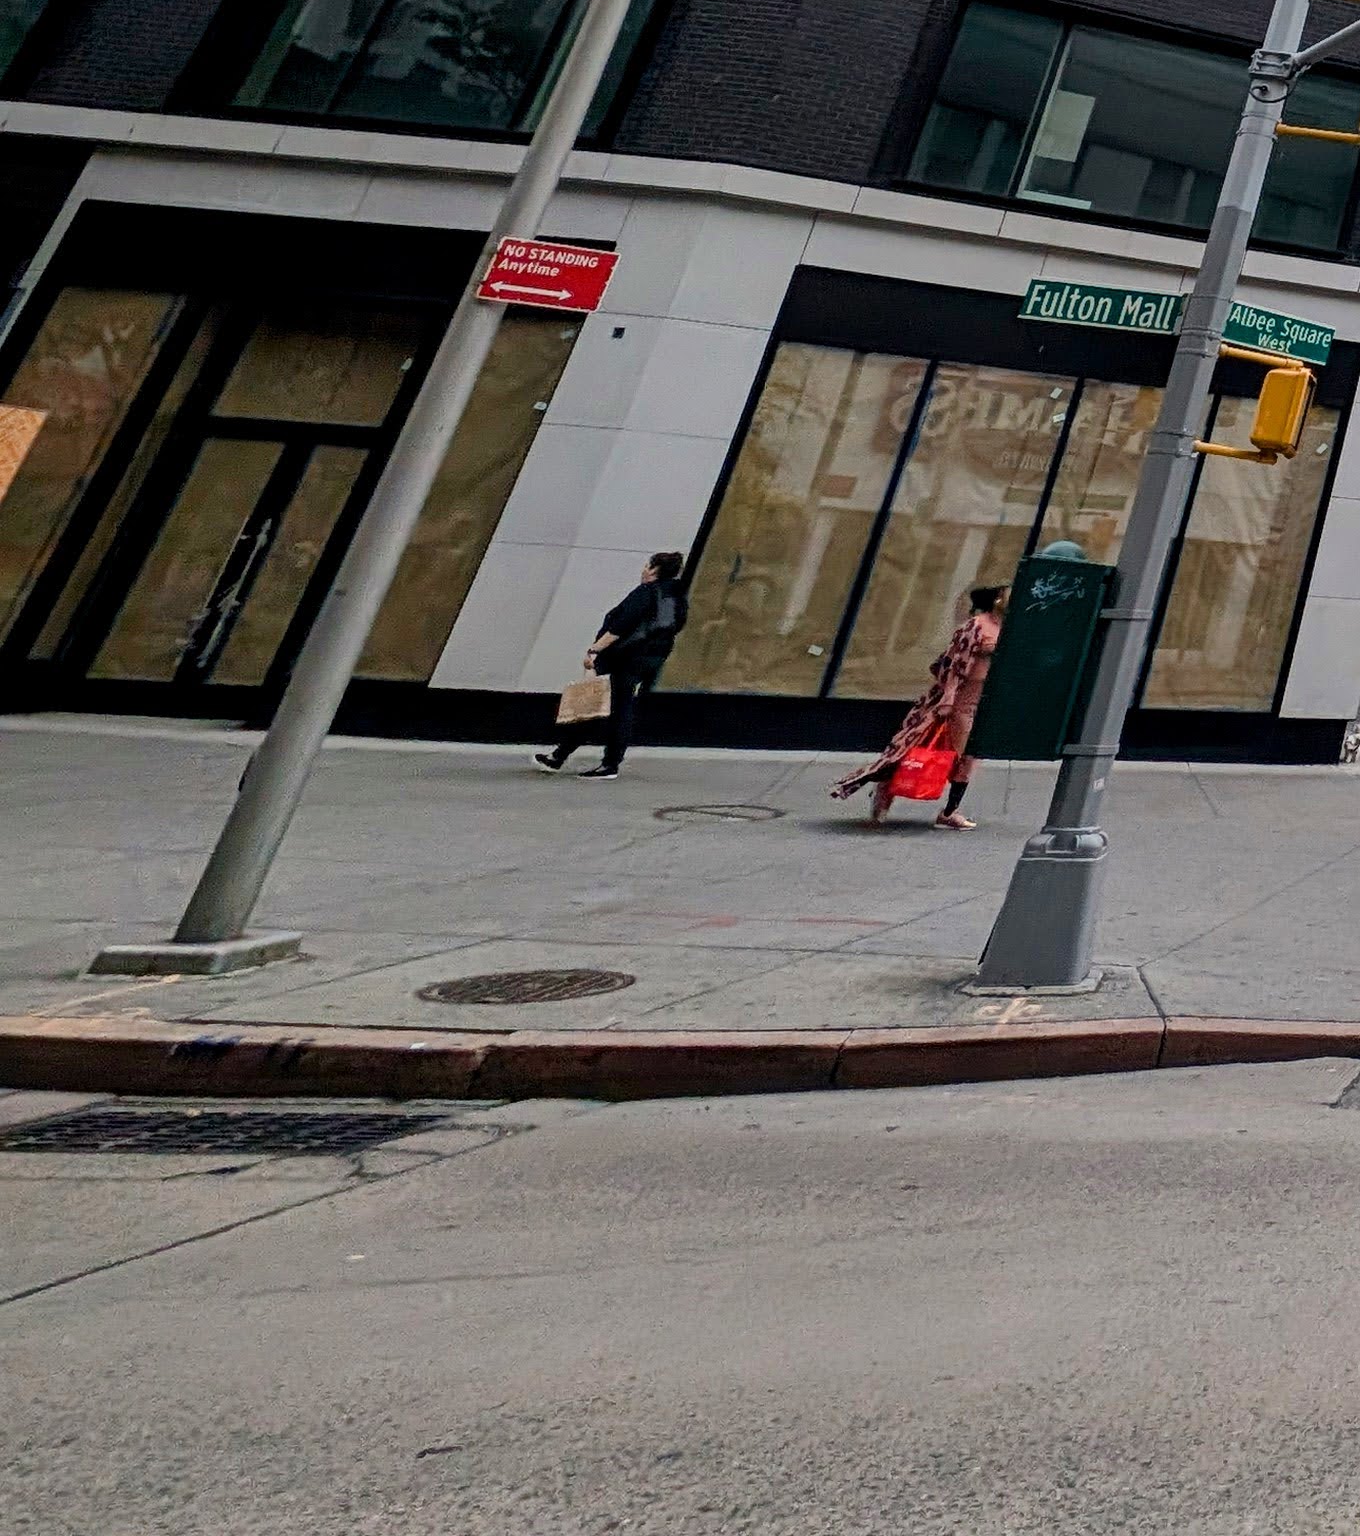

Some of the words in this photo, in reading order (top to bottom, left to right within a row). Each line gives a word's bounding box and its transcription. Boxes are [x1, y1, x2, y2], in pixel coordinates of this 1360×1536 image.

[498, 258, 560, 276] Anytime
[503, 244, 525, 257] NO
[528, 248, 599, 268] STANDING
[1025, 284, 1111, 324] Fulton
[1118, 292, 1178, 330] Mall
[1229, 306, 1276, 332] Albee
[1279, 319, 1333, 347] Square
[1257, 333, 1292, 353] West
